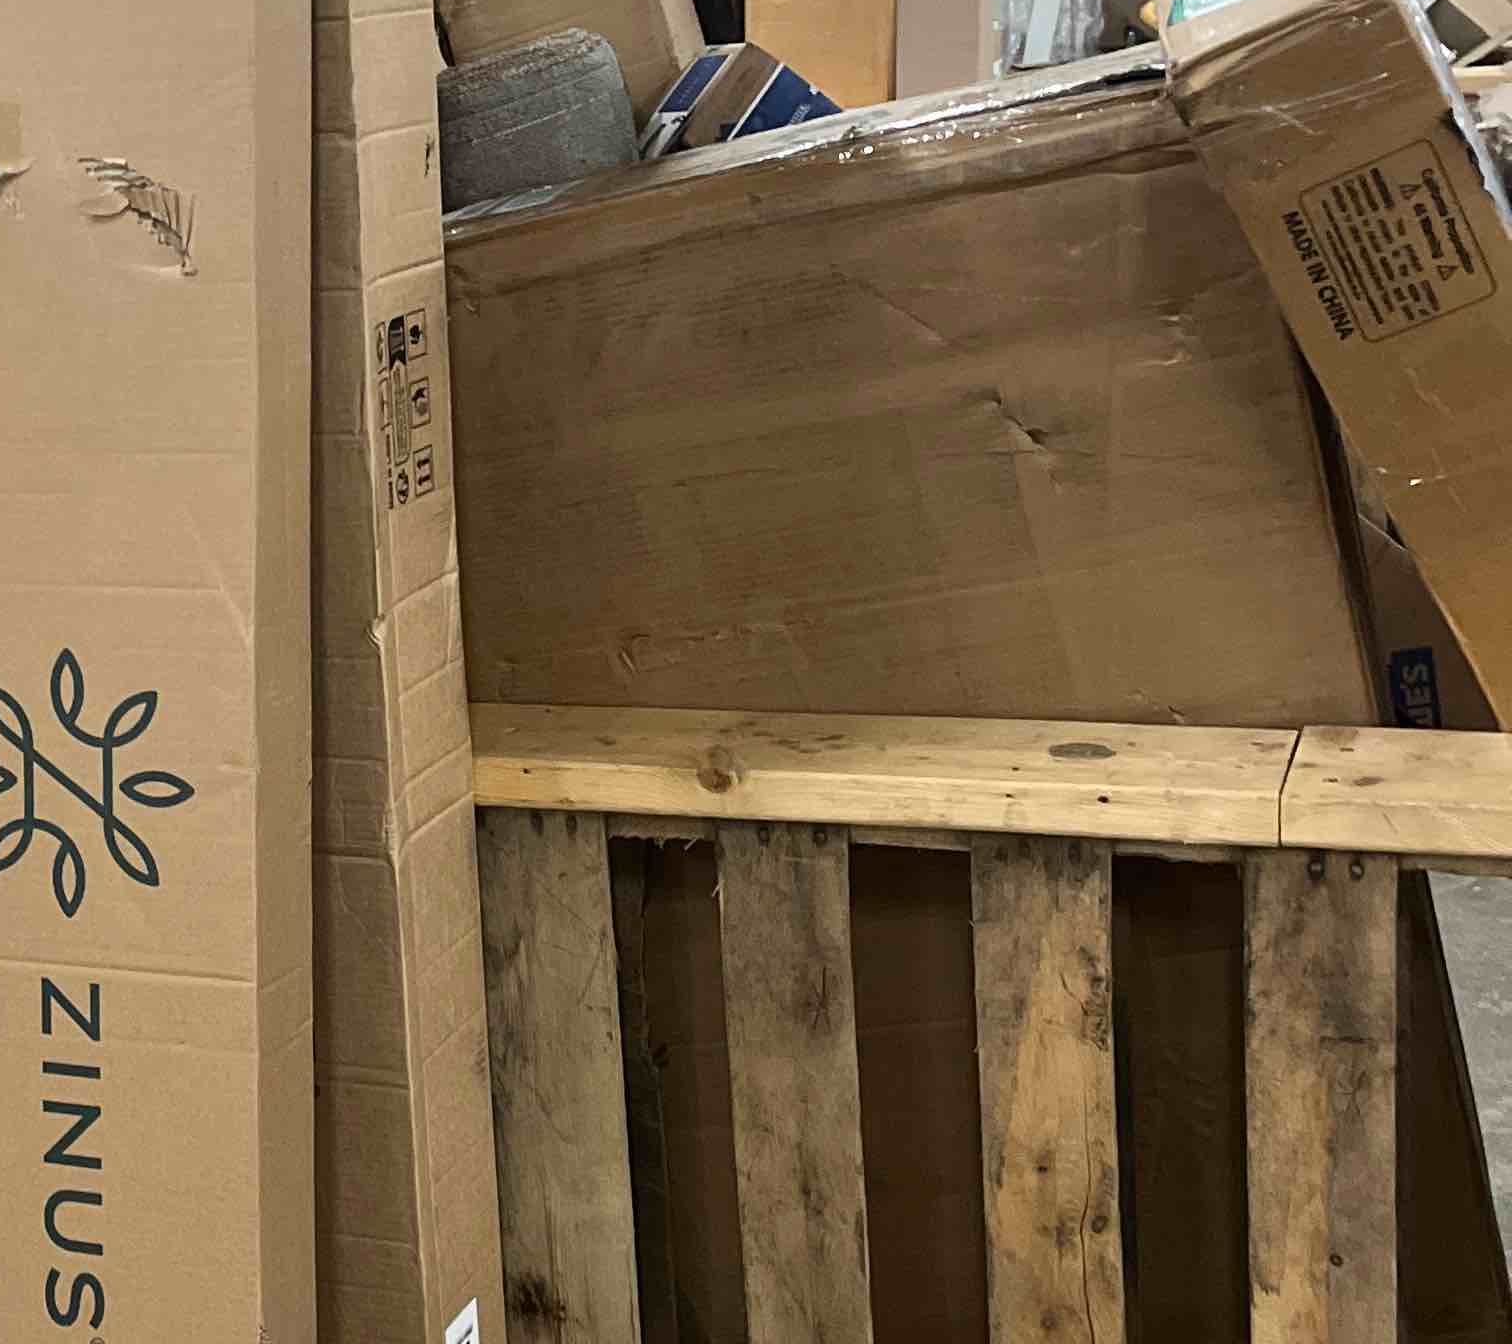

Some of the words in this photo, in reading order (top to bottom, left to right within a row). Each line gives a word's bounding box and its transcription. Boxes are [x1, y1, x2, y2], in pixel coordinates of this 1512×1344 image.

[1281, 211, 1319, 262] MADE
[1306, 259, 1329, 284] IN
[1318, 284, 1354, 340] CHINA
[41, 976, 105, 1333] ZINUS
